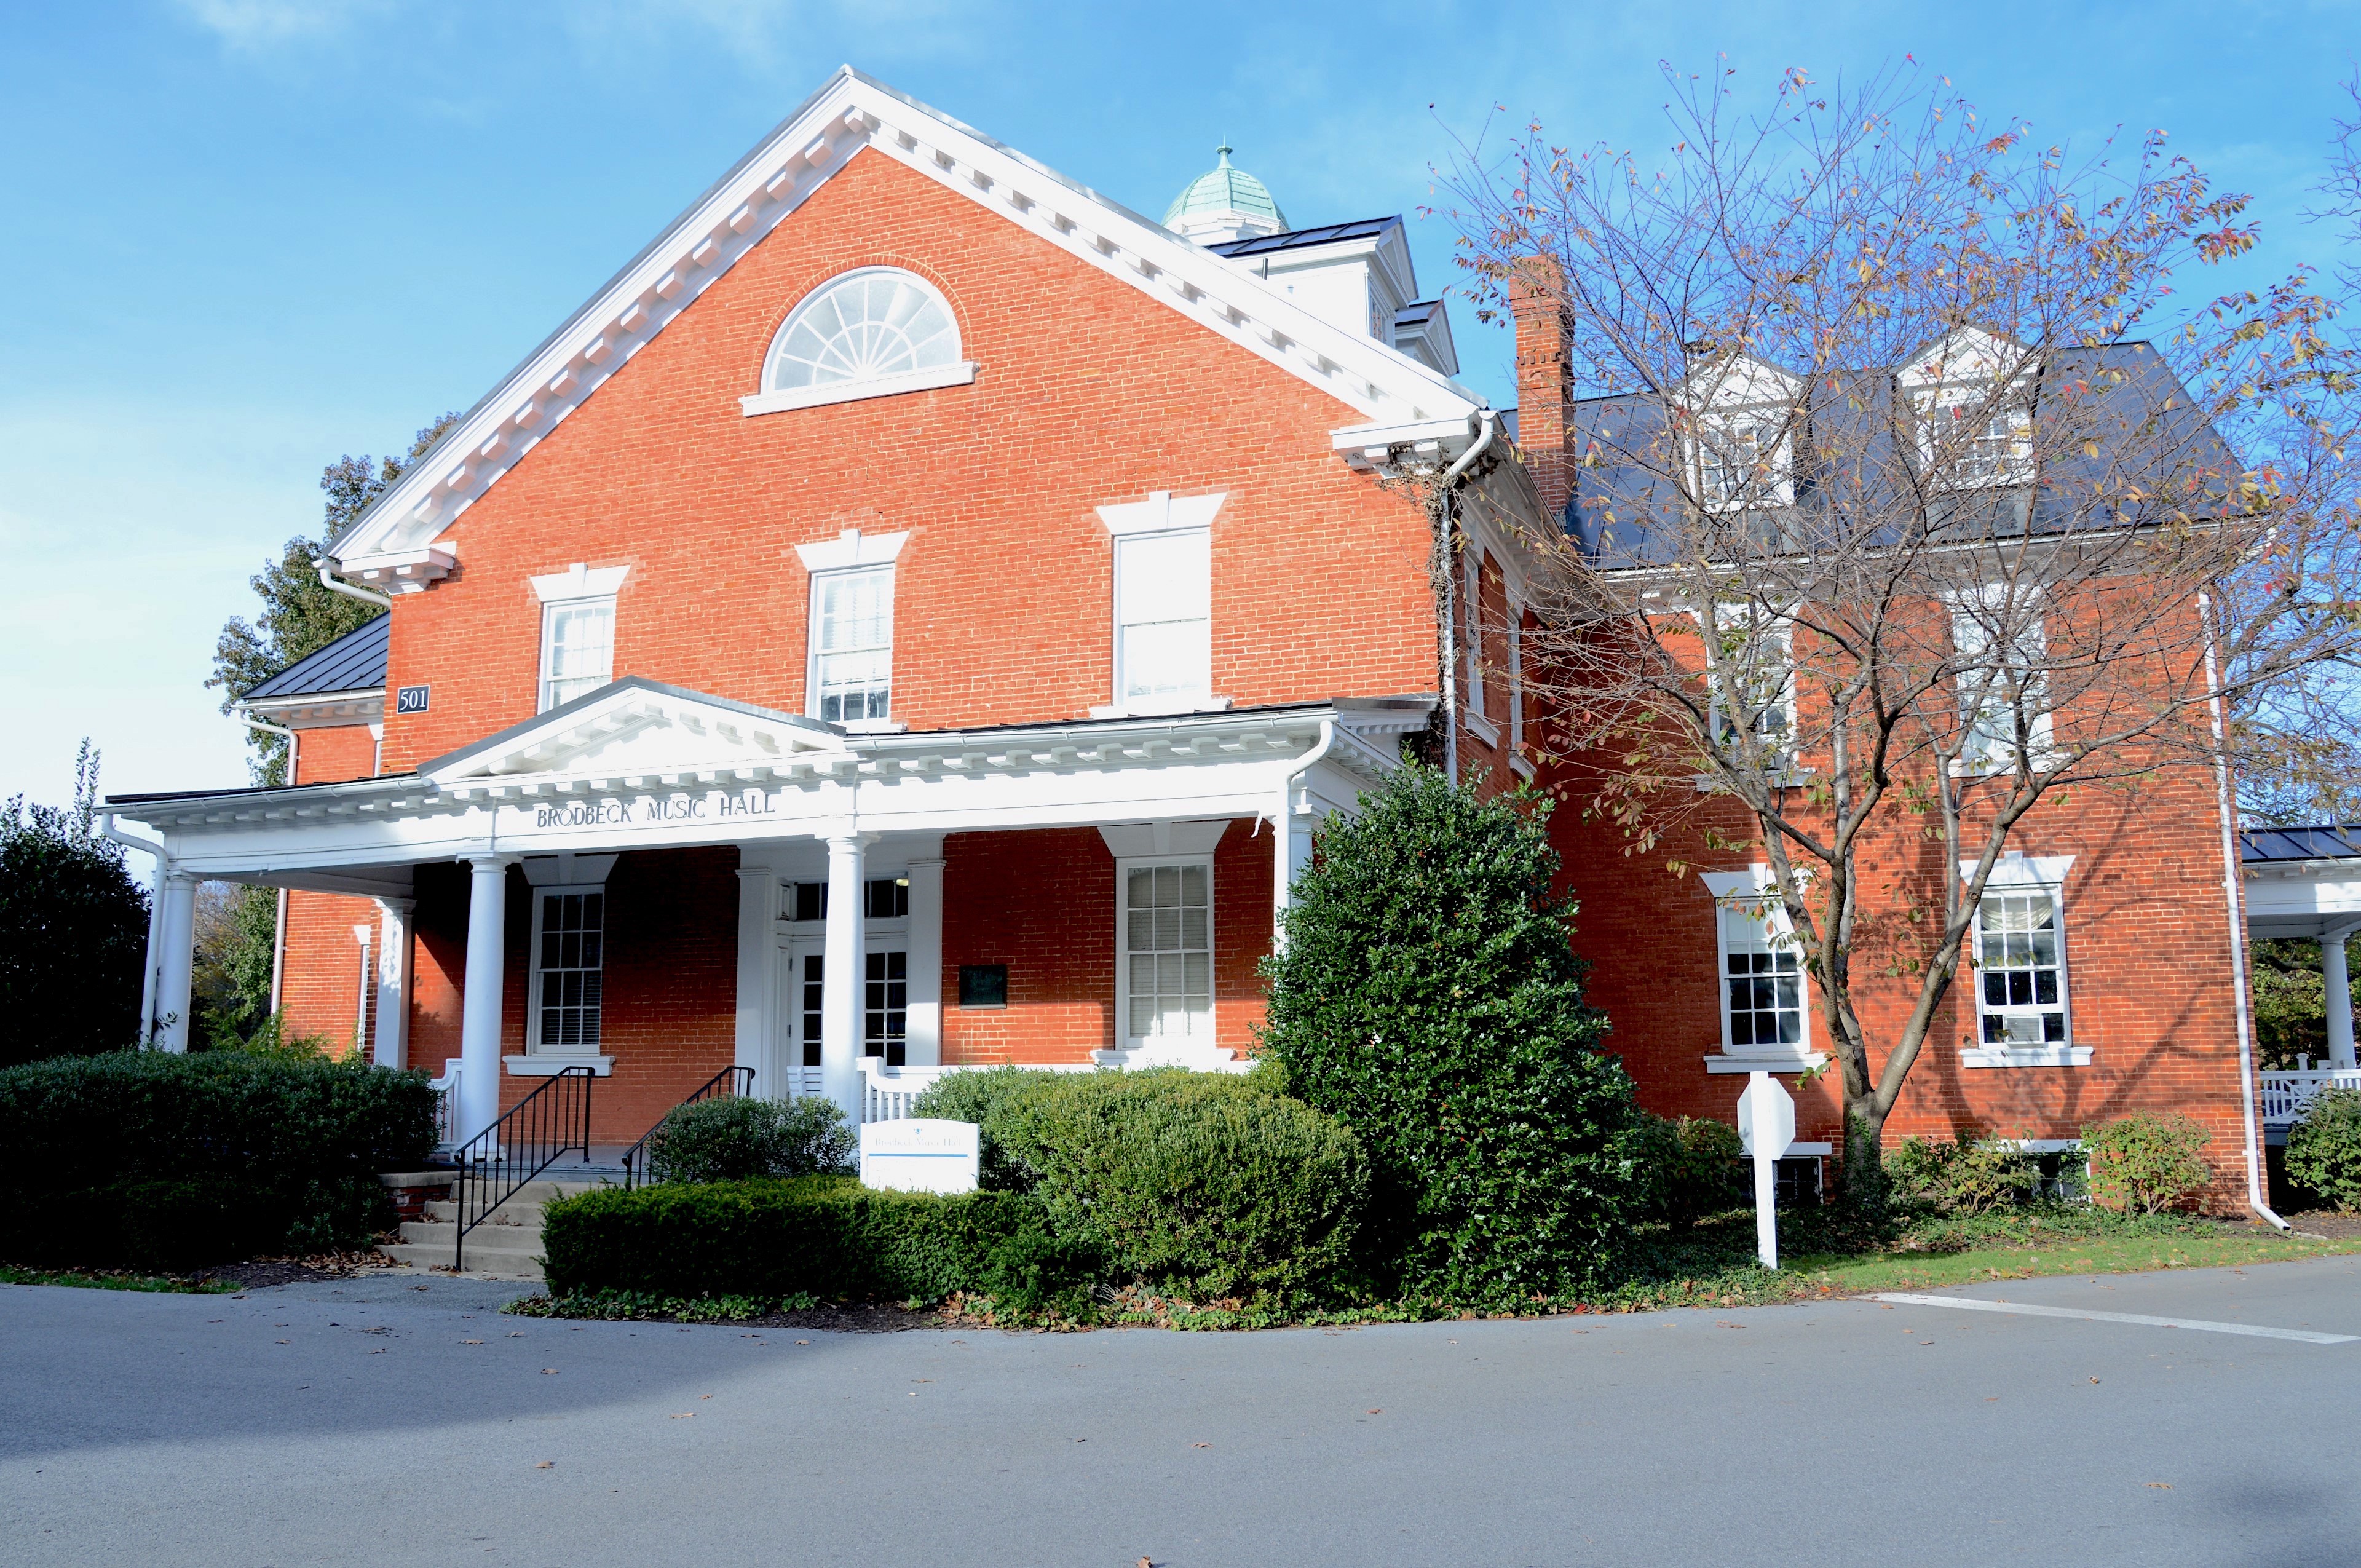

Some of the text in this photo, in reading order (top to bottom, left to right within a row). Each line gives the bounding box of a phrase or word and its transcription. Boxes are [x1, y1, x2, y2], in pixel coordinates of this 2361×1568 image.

[400, 690, 425, 711] 501
[537, 794, 775, 828] BRODBECK MUSIC HALL
